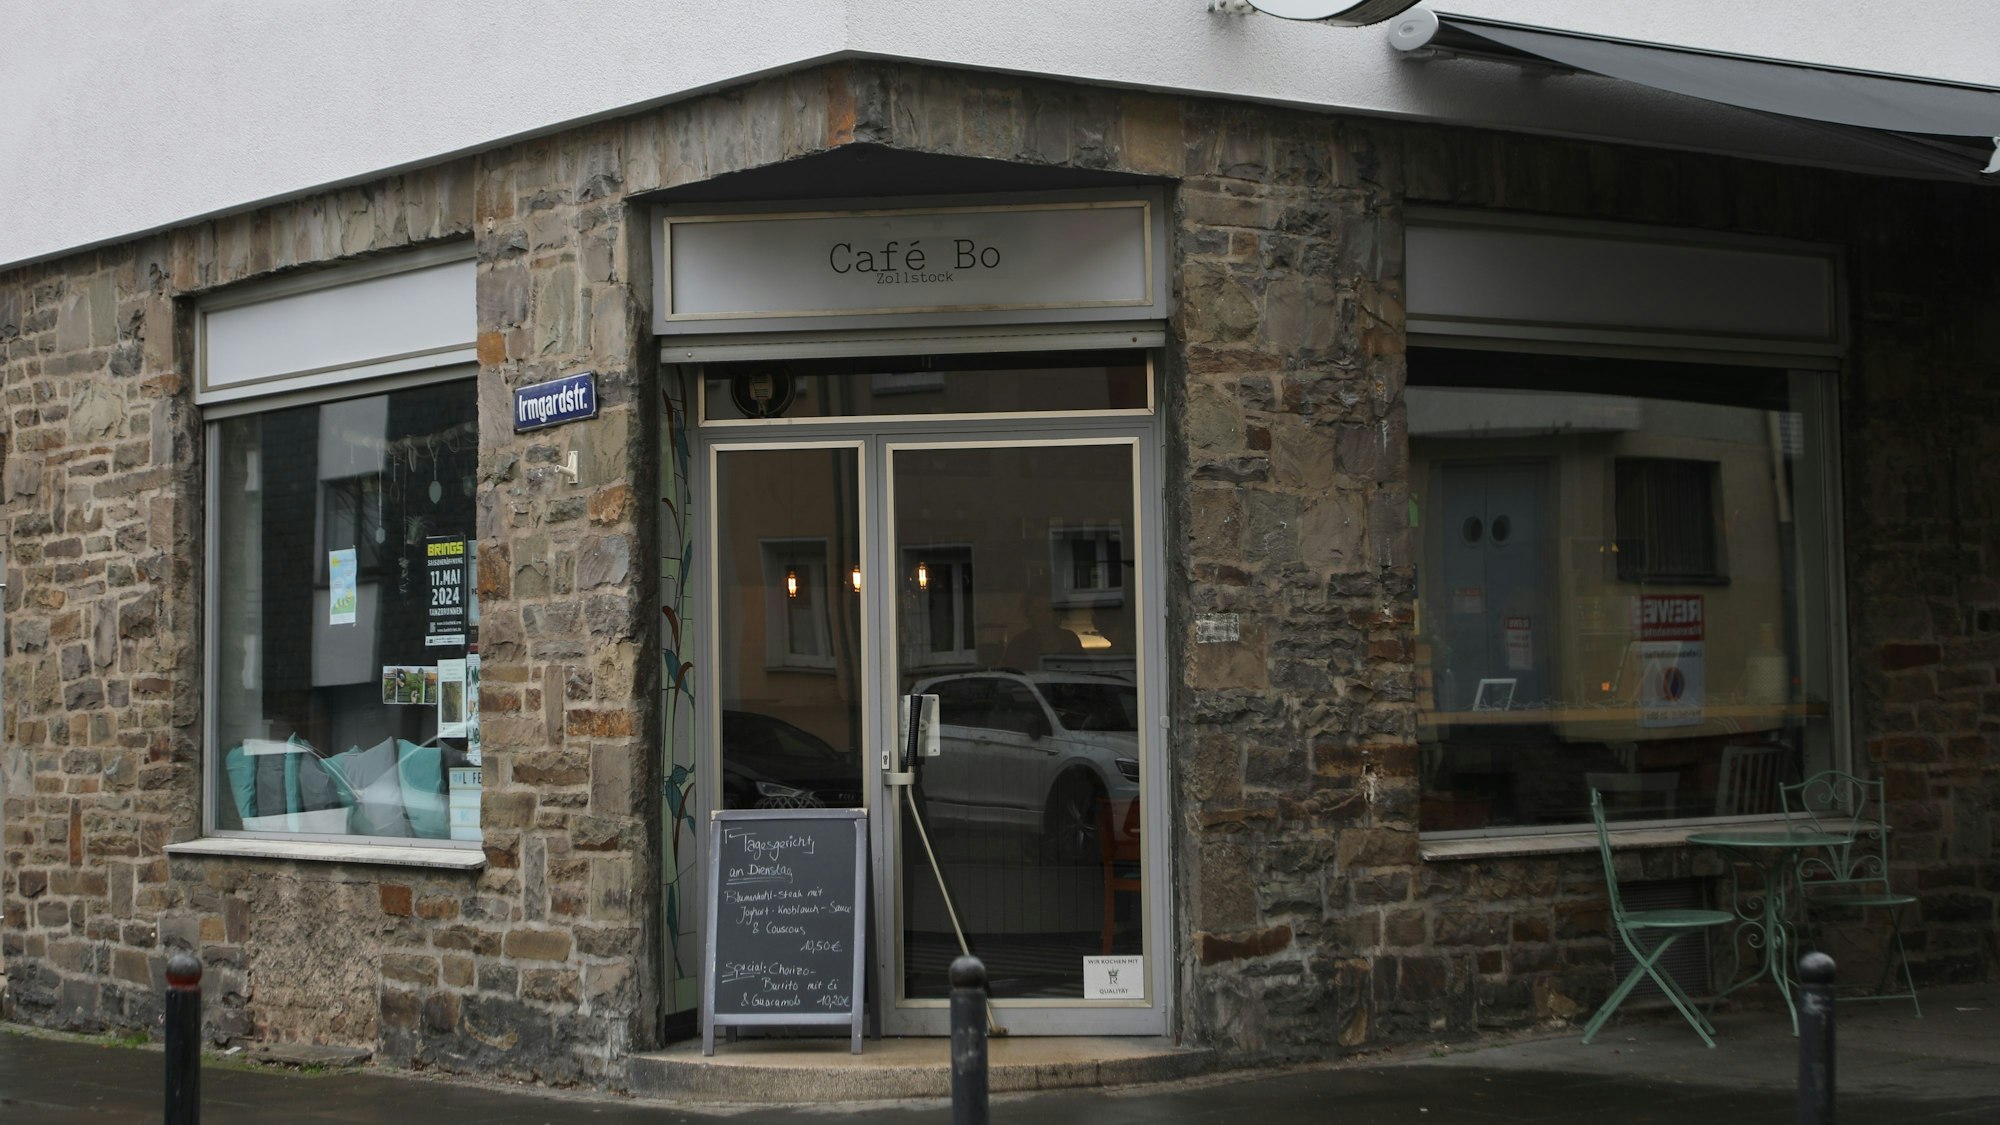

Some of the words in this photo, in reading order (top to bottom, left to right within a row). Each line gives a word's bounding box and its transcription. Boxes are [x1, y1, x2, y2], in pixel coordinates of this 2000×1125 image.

[829, 240, 925, 274] Café
[954, 239, 1001, 269] Bo
[876, 271, 954, 285] Zollstock
[518, 382, 588, 423] Irmgardstr.
[427, 541, 464, 557] BRINGS
[431, 587, 460, 606] 2024
[748, 864, 793, 884] Dienstag
[766, 921, 806, 936] Couscous
[761, 977, 799, 993] Burrito
[807, 980, 822, 991] mit
